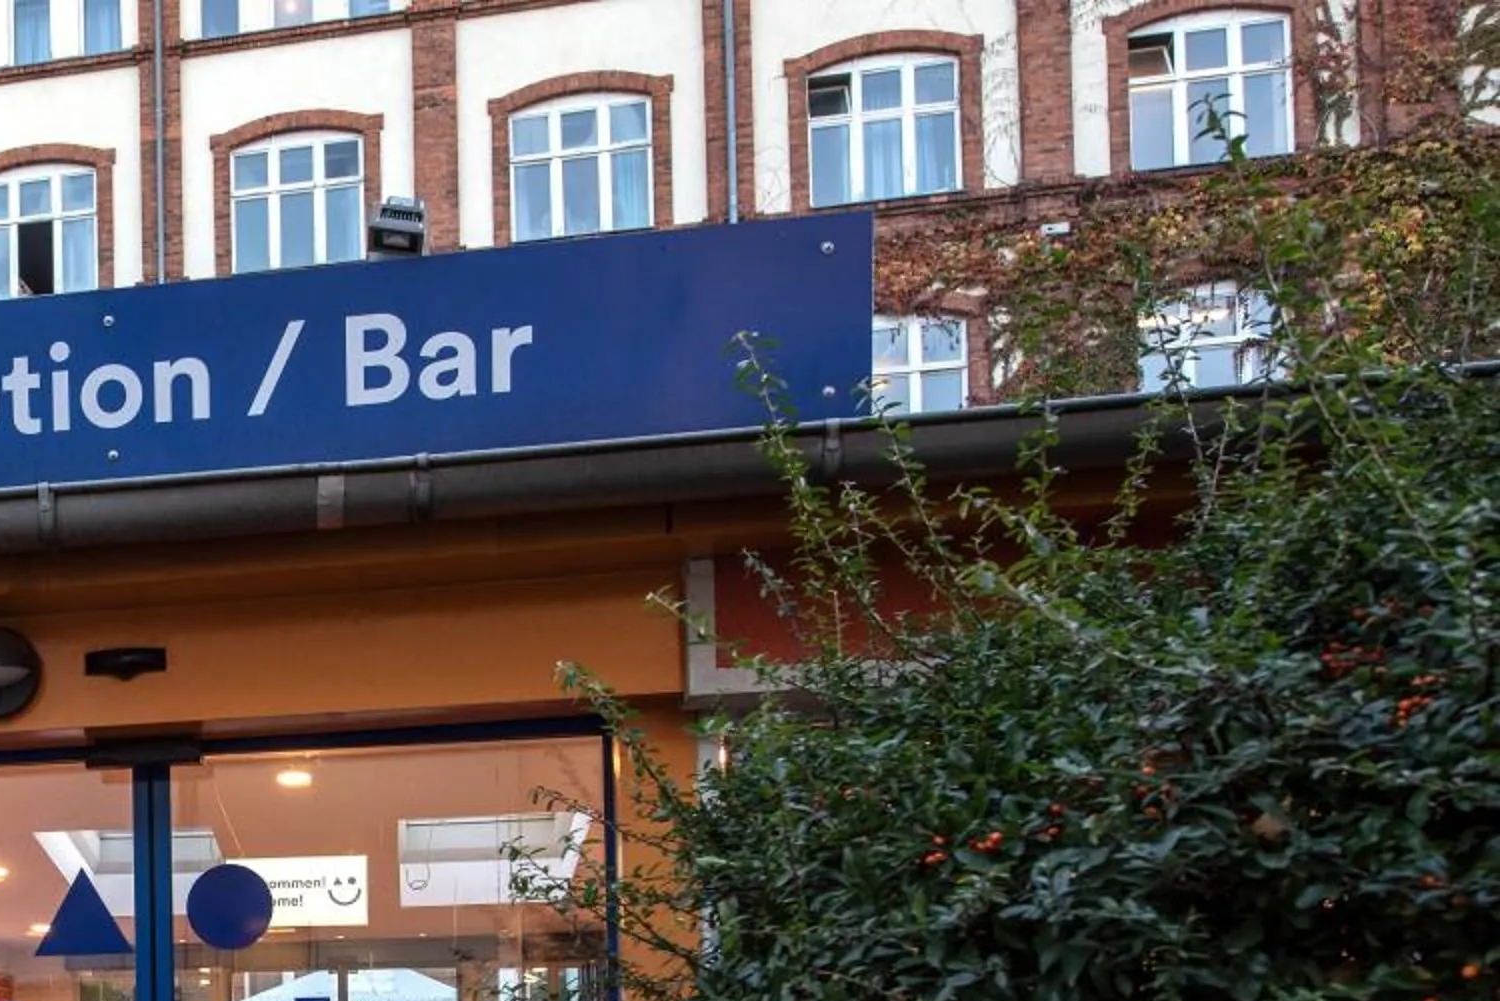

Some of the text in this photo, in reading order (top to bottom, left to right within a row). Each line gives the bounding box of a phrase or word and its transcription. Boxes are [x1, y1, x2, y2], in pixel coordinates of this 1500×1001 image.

[247, 320, 306, 416] /
[345, 313, 534, 406] Bar
[268, 876, 326, 889] ommen!
